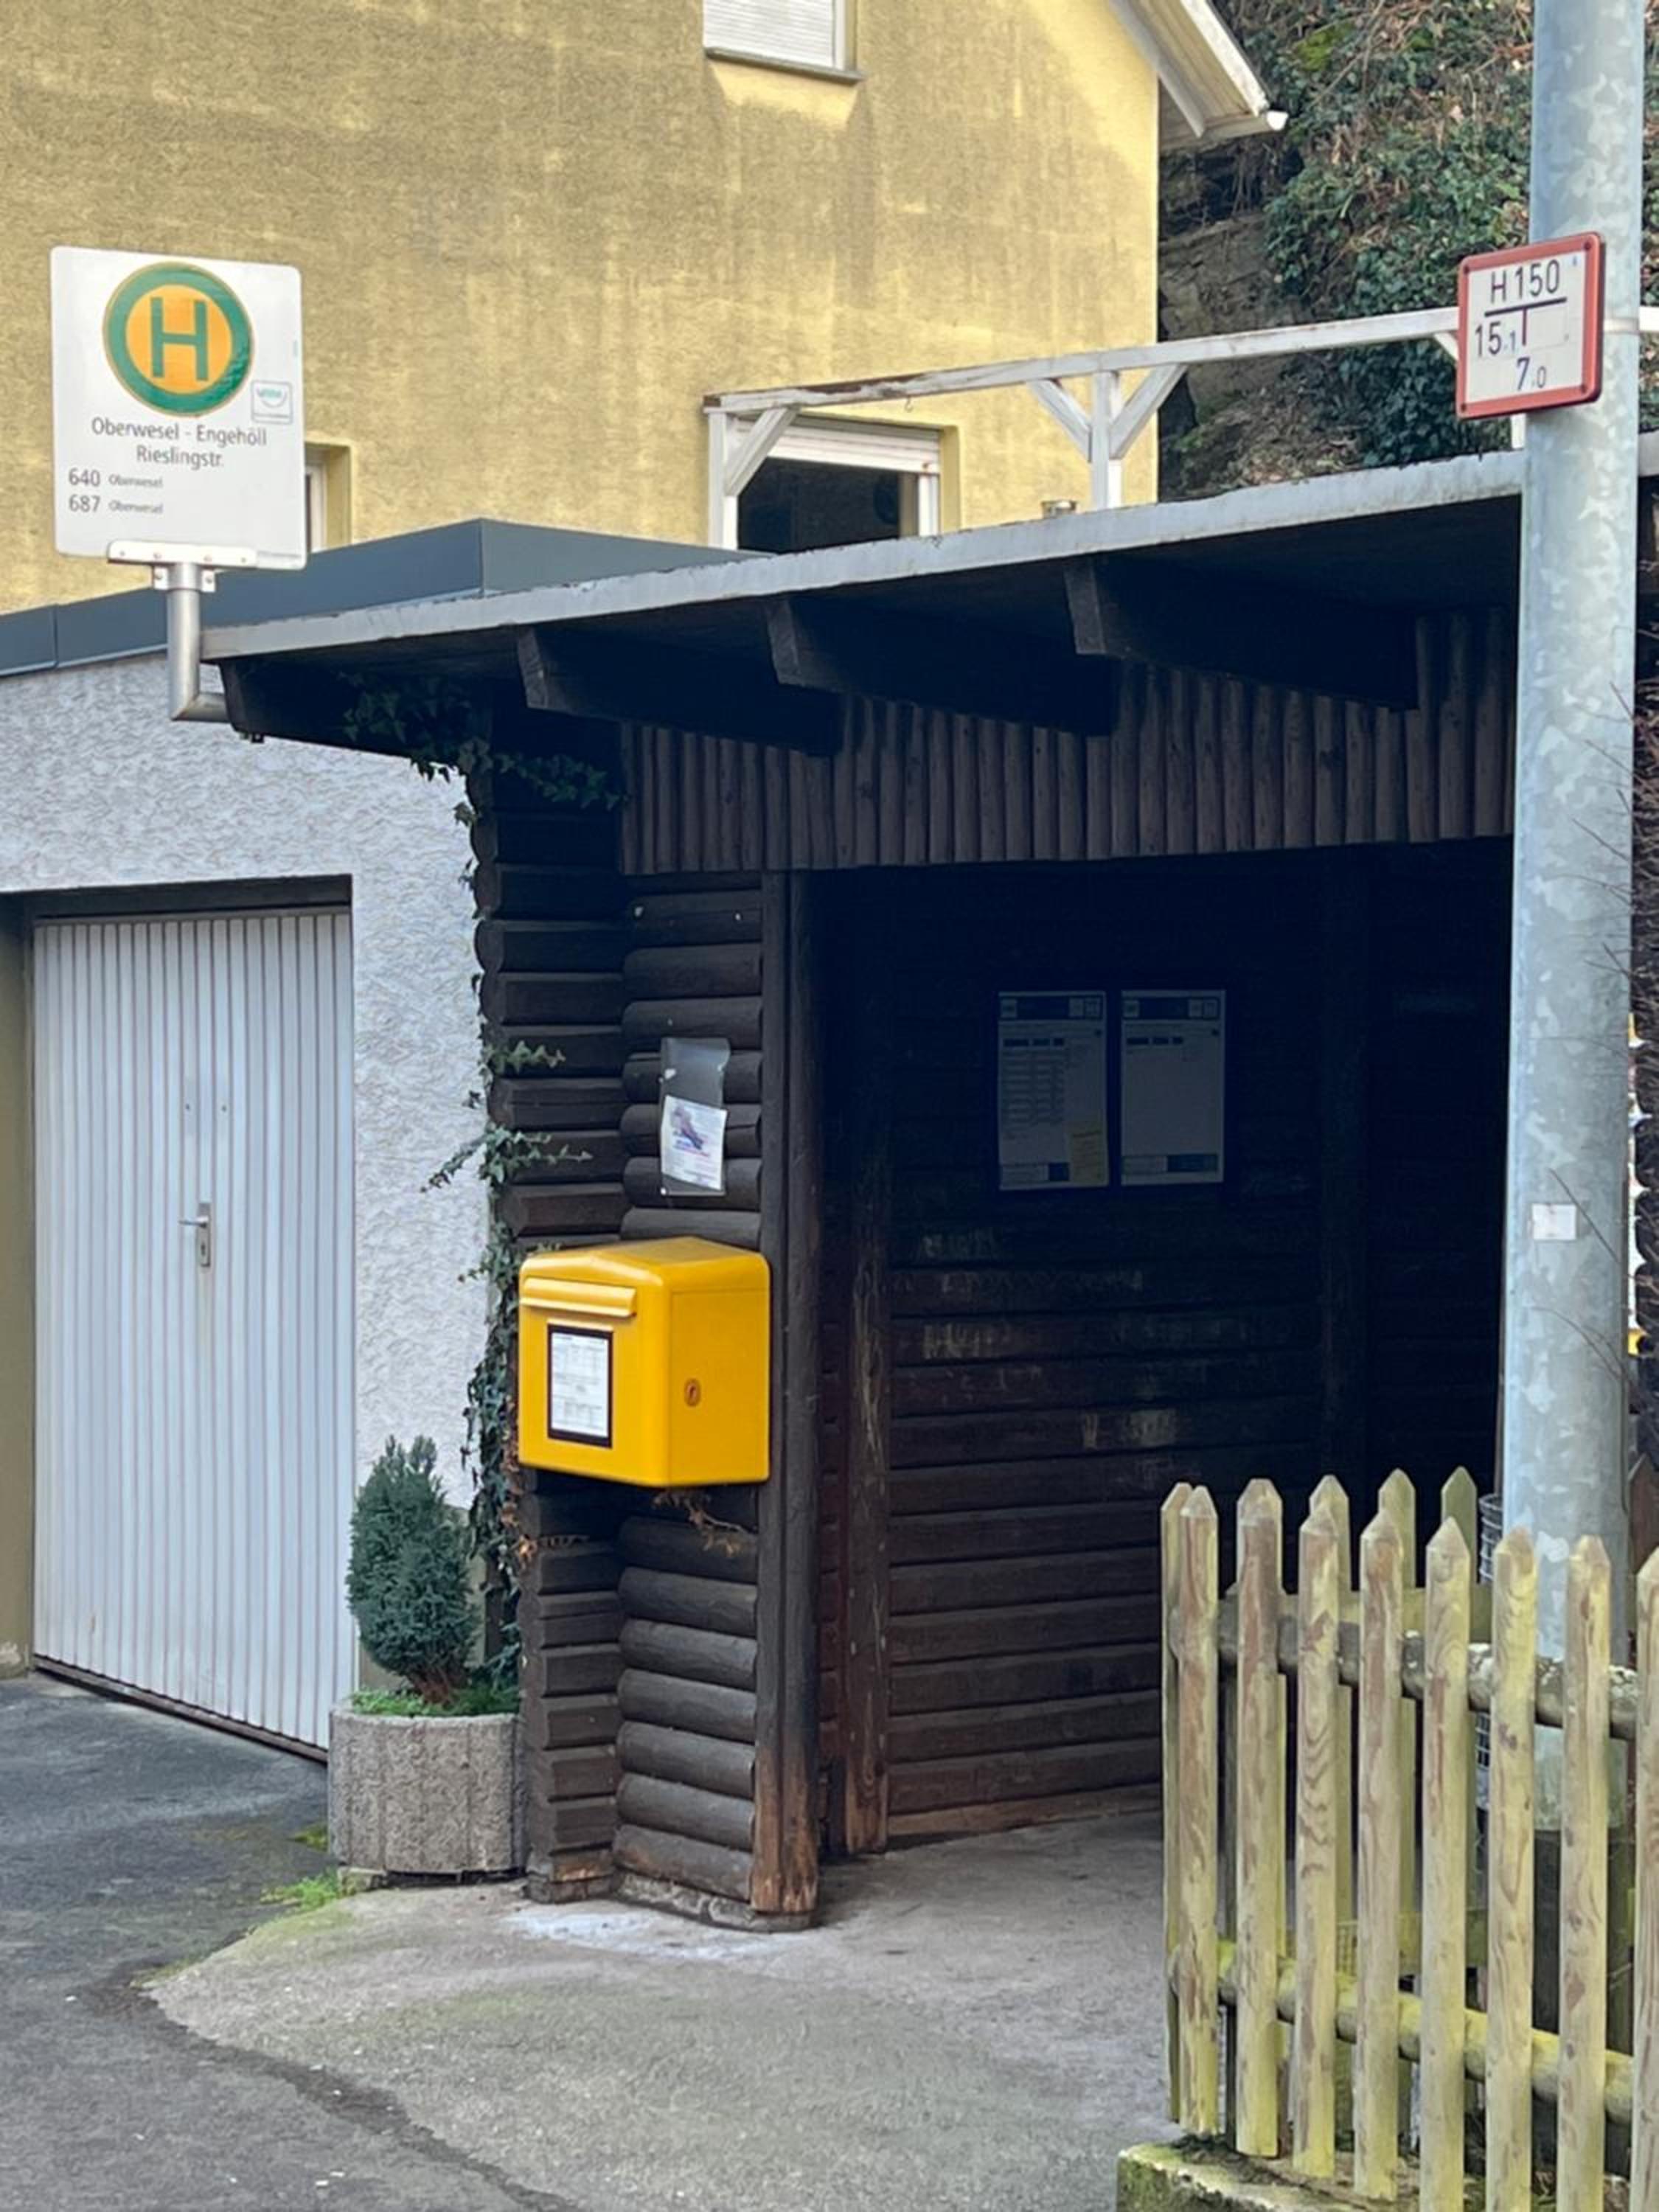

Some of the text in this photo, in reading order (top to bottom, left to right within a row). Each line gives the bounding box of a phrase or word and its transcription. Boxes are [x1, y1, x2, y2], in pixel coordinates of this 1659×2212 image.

[150, 296, 209, 382] H
[91, 417, 180, 440] Oberwesel
[196, 424, 268, 448] Engehöll
[68, 468, 101, 487] 640
[68, 495, 101, 512] 687
